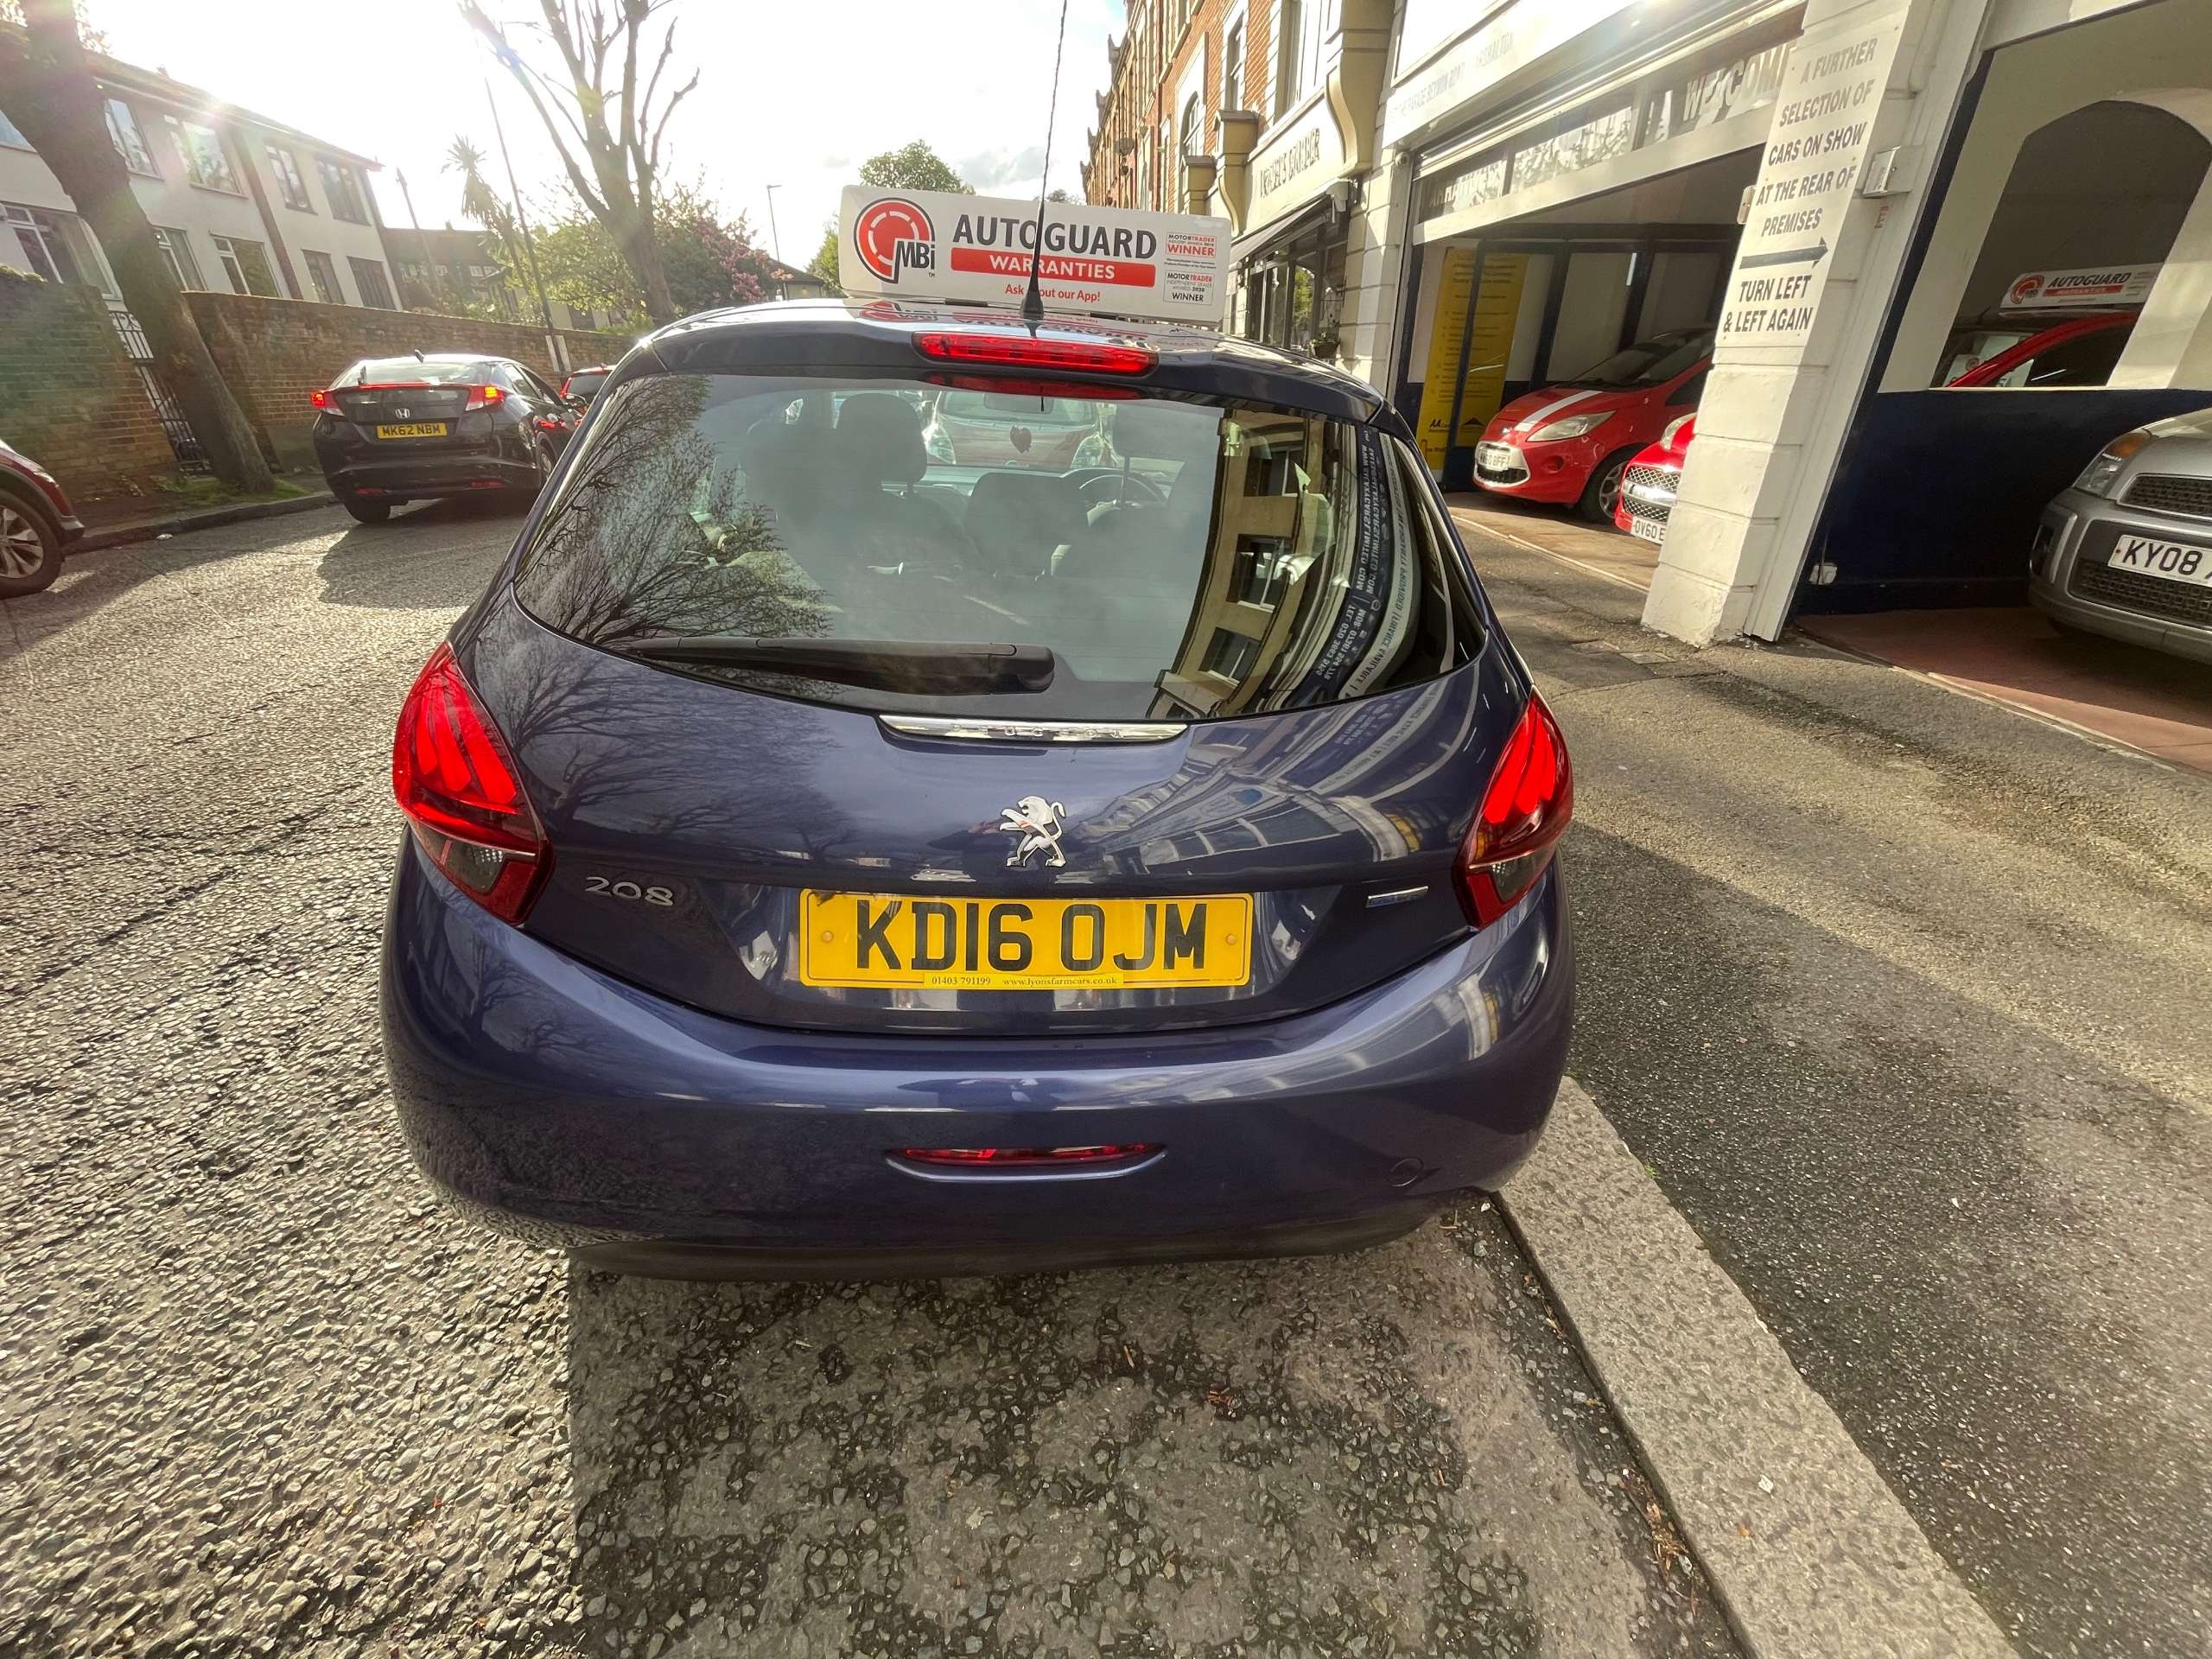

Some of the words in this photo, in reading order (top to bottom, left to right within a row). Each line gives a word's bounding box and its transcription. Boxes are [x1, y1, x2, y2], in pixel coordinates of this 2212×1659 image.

[1800, 60, 1812, 85] A
[1813, 39, 1878, 80] FURTHER
[1780, 86, 1852, 127] SELECTION
[1853, 79, 1875, 106] OF
[1769, 139, 1801, 166] CARS
[1802, 133, 1823, 157] ON
[1824, 122, 1867, 153] SHOW
[1756, 184, 1774, 206] AT
[1774, 178, 1799, 202] THE
[1798, 170, 1834, 197] REAR
[1835, 165, 1857, 189] OF
[952, 213, 1158, 260] AUTOGUARD
[1761, 208, 1822, 237] PREMISES
[1167, 244, 1214, 256] WINNER
[989, 254, 1116, 280] WARRANTIES
[2047, 272, 2133, 289] AUTOGUARD
[1005, 283, 1024, 296] Ask
[1058, 290, 1074, 300] our
[1077, 289, 1101, 302] App!
[1172, 292, 1204, 302] WINNER
[1738, 277, 1776, 302] TURN
[1775, 275, 1813, 299] LEFT
[1723, 311, 1733, 333] &
[1734, 309, 1769, 333] LEFT
[1766, 307, 1814, 332] AGAIN
[1635, 520, 1657, 539] OV60
[2121, 539, 2203, 575] KY08
[585, 876, 674, 906] 208
[856, 899, 1034, 972] KD16
[1060, 903, 1209, 971] OJM
[931, 976, 958, 985] 01403
[961, 976, 991, 985] 791199
[1003, 976, 1117, 988] www.lyonsfarmcars.co.uk
